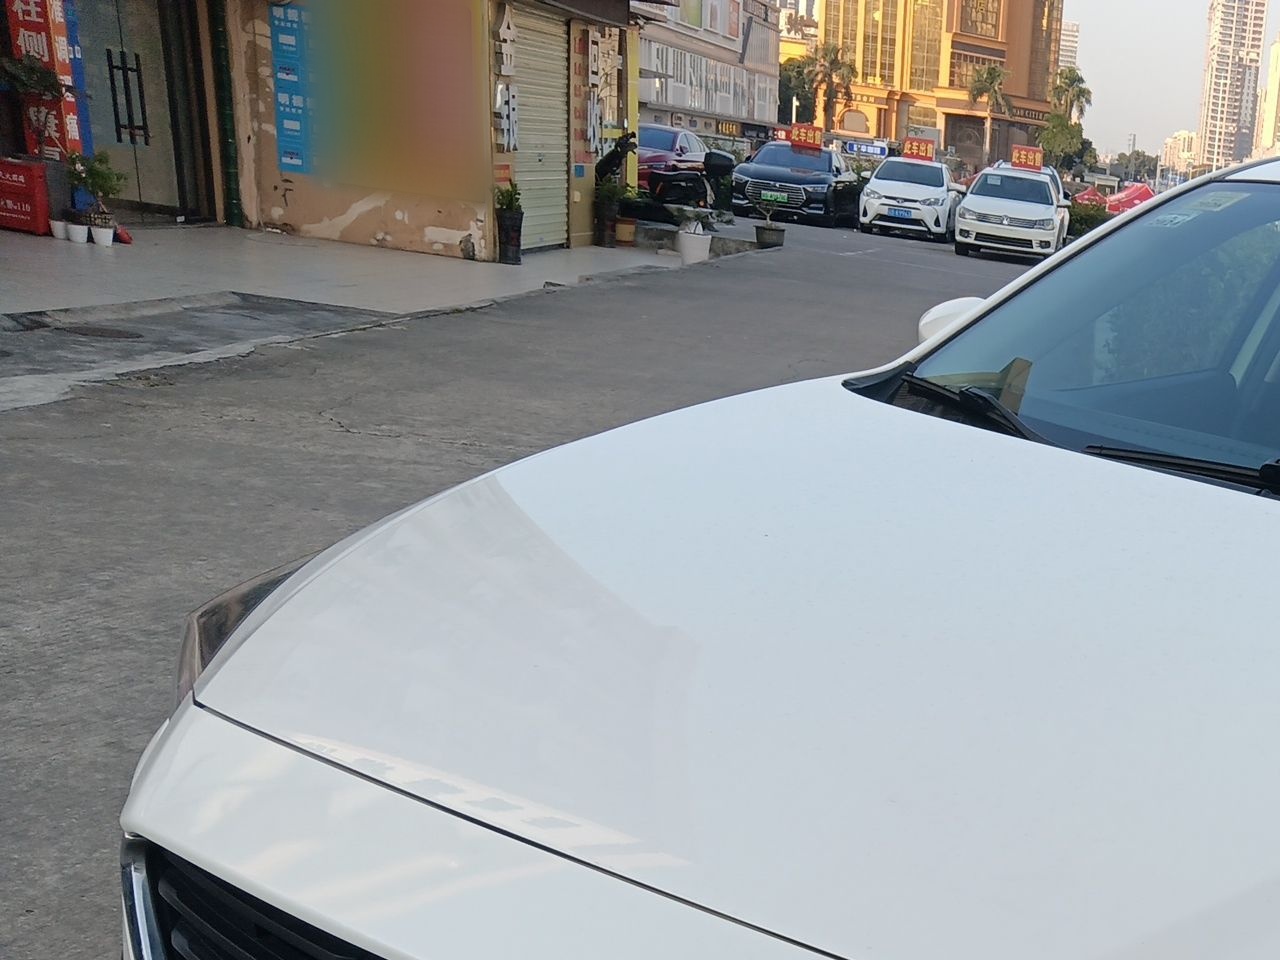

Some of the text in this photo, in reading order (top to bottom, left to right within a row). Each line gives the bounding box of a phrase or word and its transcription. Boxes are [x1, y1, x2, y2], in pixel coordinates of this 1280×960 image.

[791, 126, 822, 145] 此车出售
[903, 140, 934, 159] 此车出售
[1012, 149, 1043, 168] 此车出售
